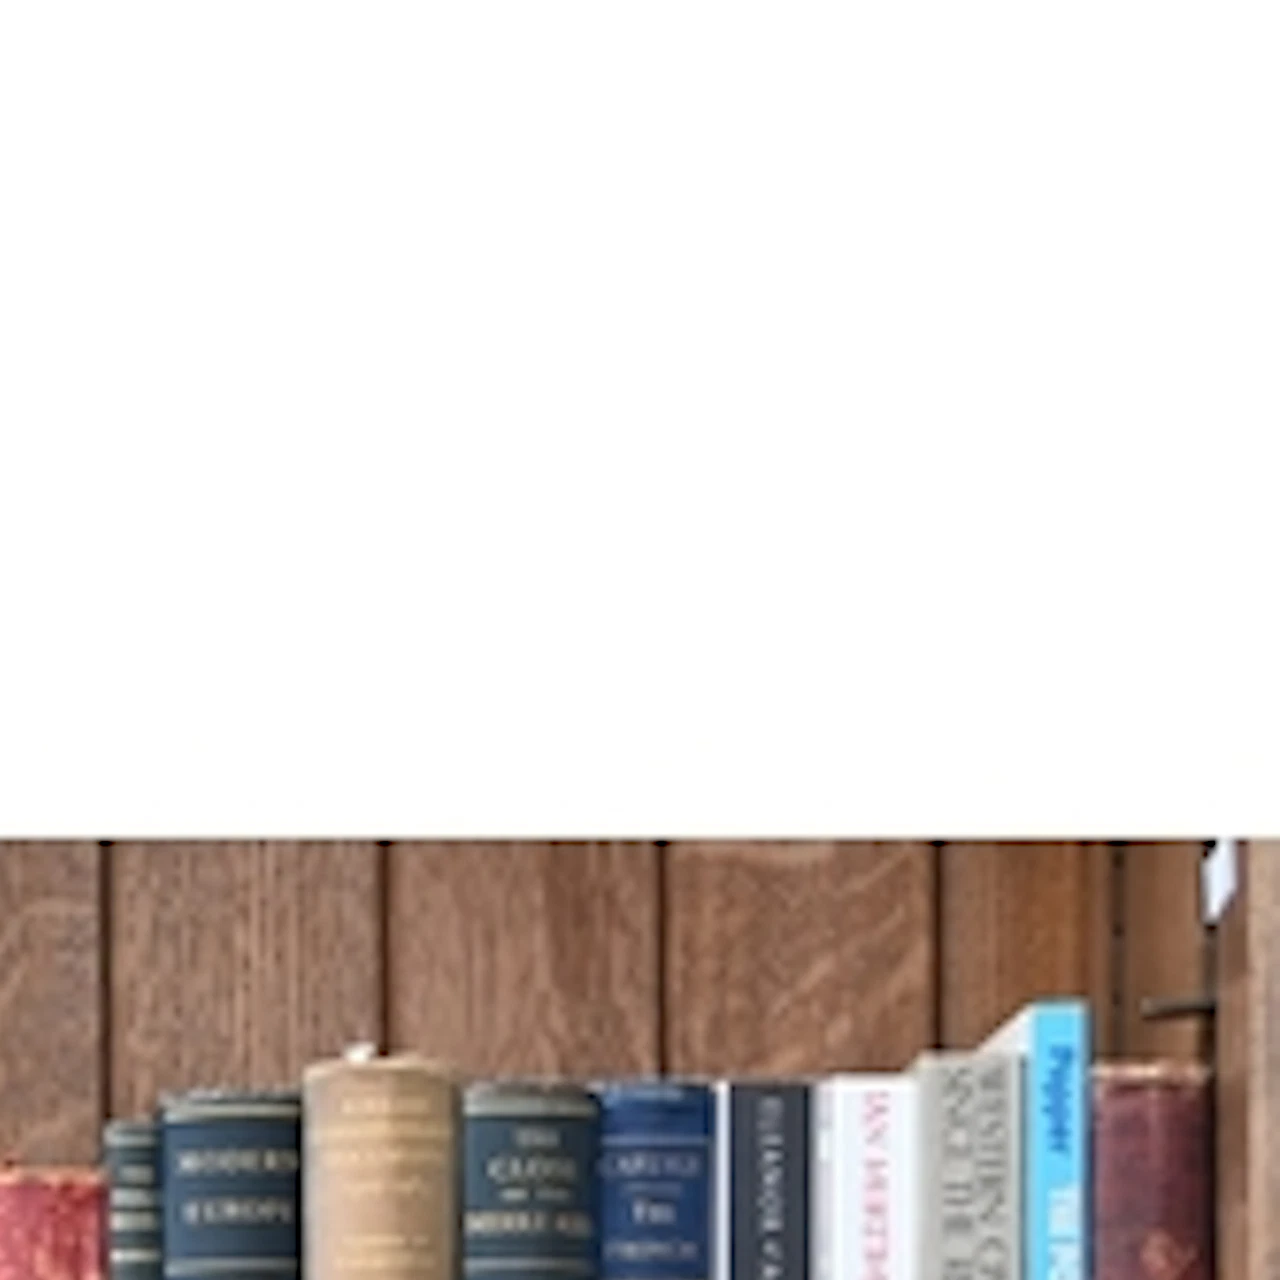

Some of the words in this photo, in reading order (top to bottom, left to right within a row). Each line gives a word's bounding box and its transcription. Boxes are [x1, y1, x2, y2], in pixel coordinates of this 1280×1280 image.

[861, 1090, 891, 1148] IAN
[940, 1066, 973, 1167] SINCE
[974, 1066, 1006, 1224] WESTERN
[1043, 1044, 1075, 1157] Popper
[182, 1198, 293, 1225] EUROPE
[756, 1095, 784, 1233] ELEANOR
[940, 1177, 973, 1239] THE
